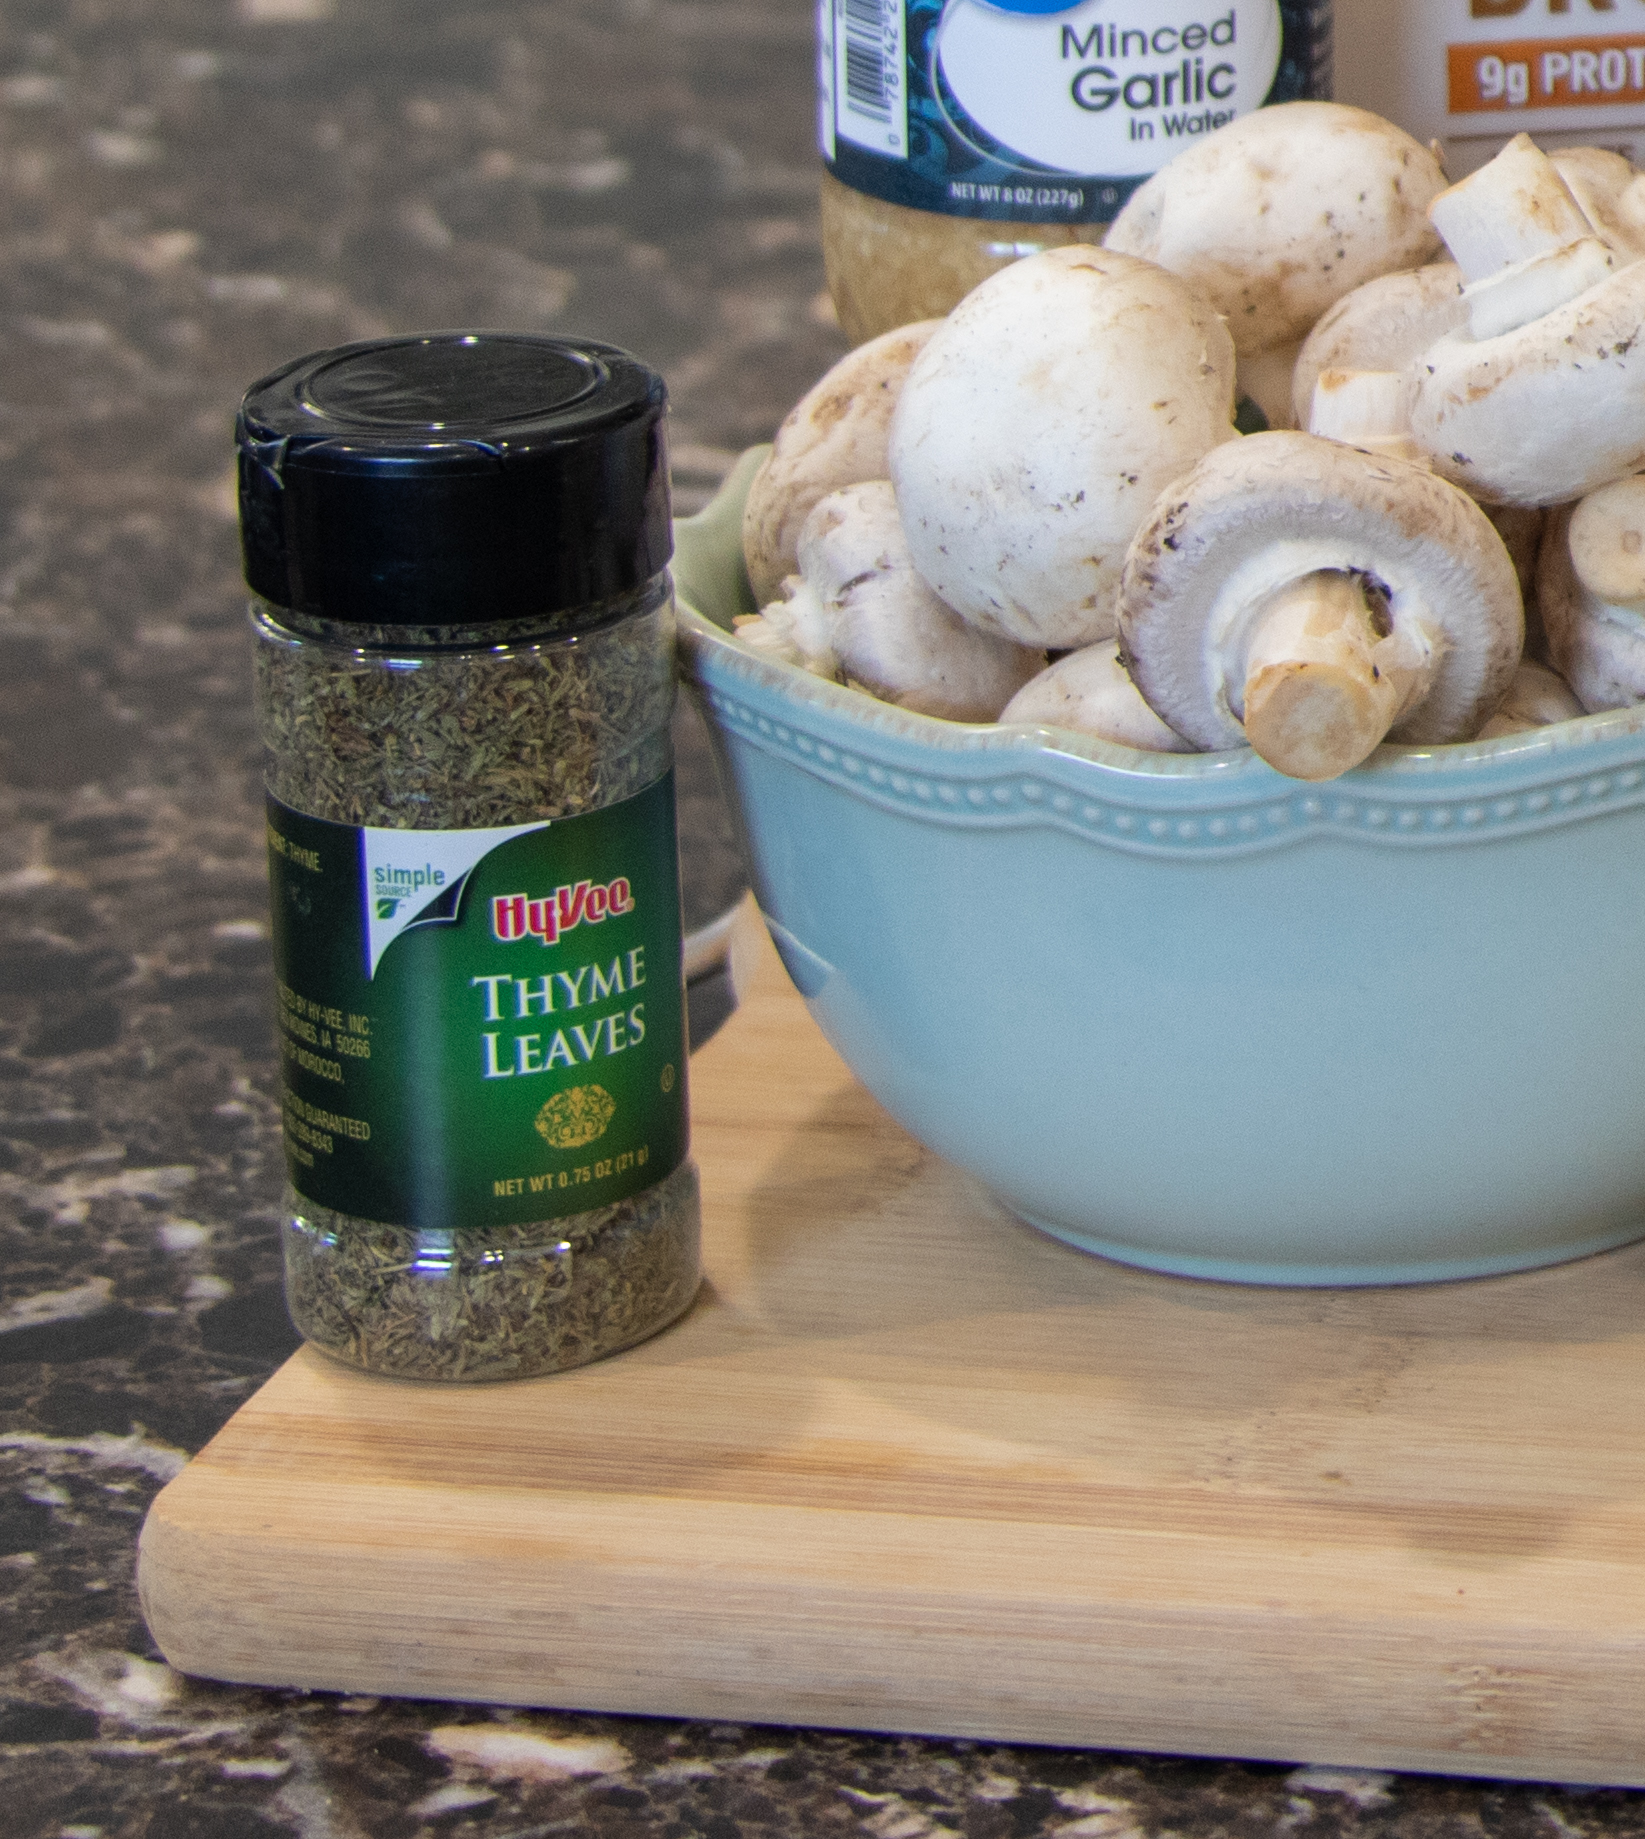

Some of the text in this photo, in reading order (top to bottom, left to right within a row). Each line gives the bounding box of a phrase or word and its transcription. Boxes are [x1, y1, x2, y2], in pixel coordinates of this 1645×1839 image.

[1060, 9, 1238, 60] Minced
[882, 25, 899, 101] 78742
[1479, 53, 1530, 104] 9g
[1069, 57, 1238, 113] Garlic
[1129, 108, 1238, 141] In Water
[950, 181, 1085, 210] NET WT 8 OZ (227g)
[374, 863, 446, 893] simple
[375, 885, 412, 897] SOURCE
[470, 945, 647, 1023] THYME
[347, 1013, 373, 1036] INC.
[480, 1002, 646, 1080] LEAVES
[336, 1033, 371, 1059] 50266
[305, 1101, 371, 1142] GUARANTEED
[493, 1178, 525, 1197] NET
[529, 1173, 554, 1193] WT
[558, 1166, 591, 1188] 0.75
[594, 1159, 613, 1179] OZ
